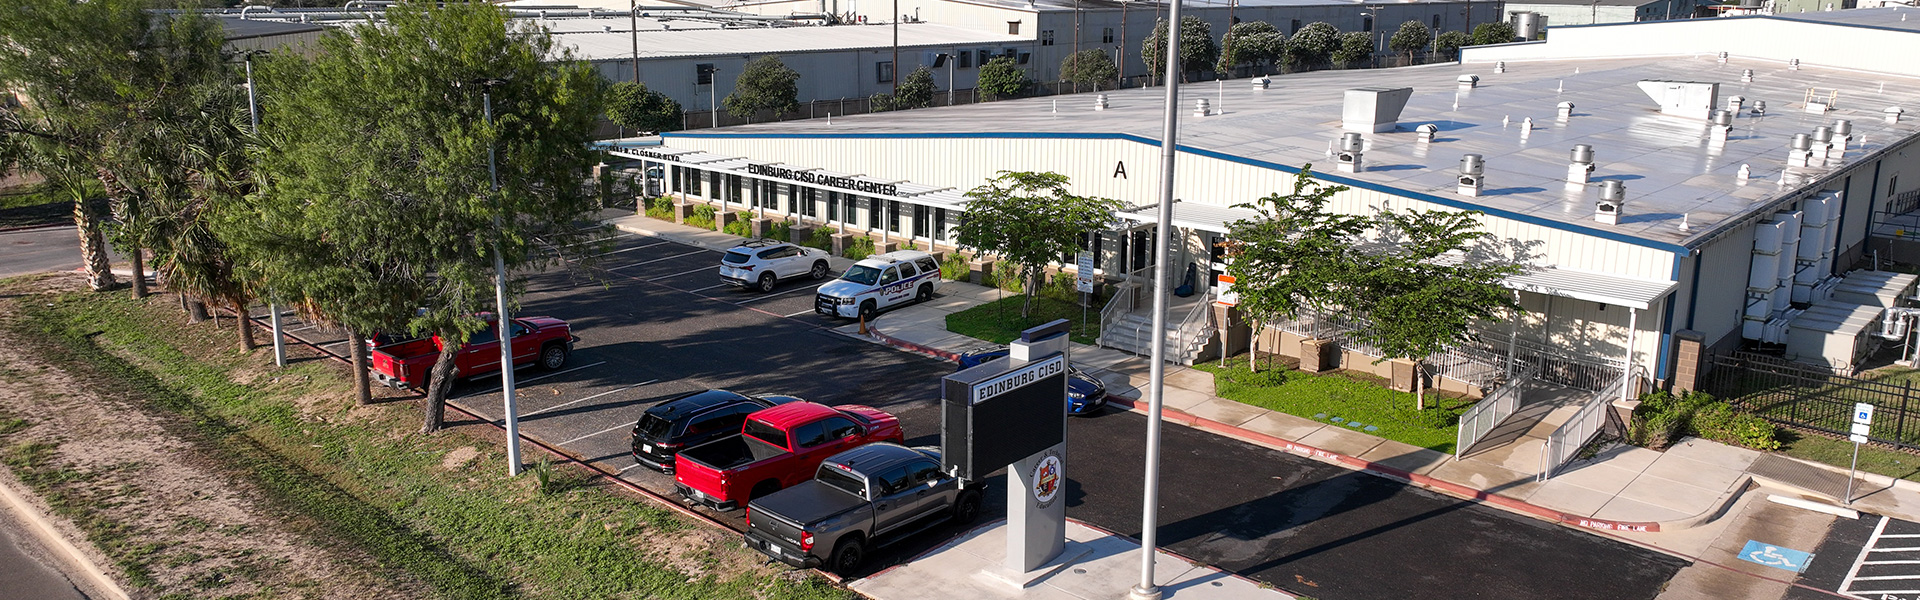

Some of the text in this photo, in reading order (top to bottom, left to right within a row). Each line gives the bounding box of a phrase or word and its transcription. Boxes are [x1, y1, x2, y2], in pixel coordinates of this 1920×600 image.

[631, 149, 662, 160] CLOSNER
[1113, 161, 1127, 179] A
[748, 163, 899, 197] EDINBURG CISD CAREER CENTER
[885, 281, 914, 295] POLICE
[979, 360, 1062, 400] EDINBURG CISD
[1580, 519, 1648, 533] NO PARKING FIRE LANE
